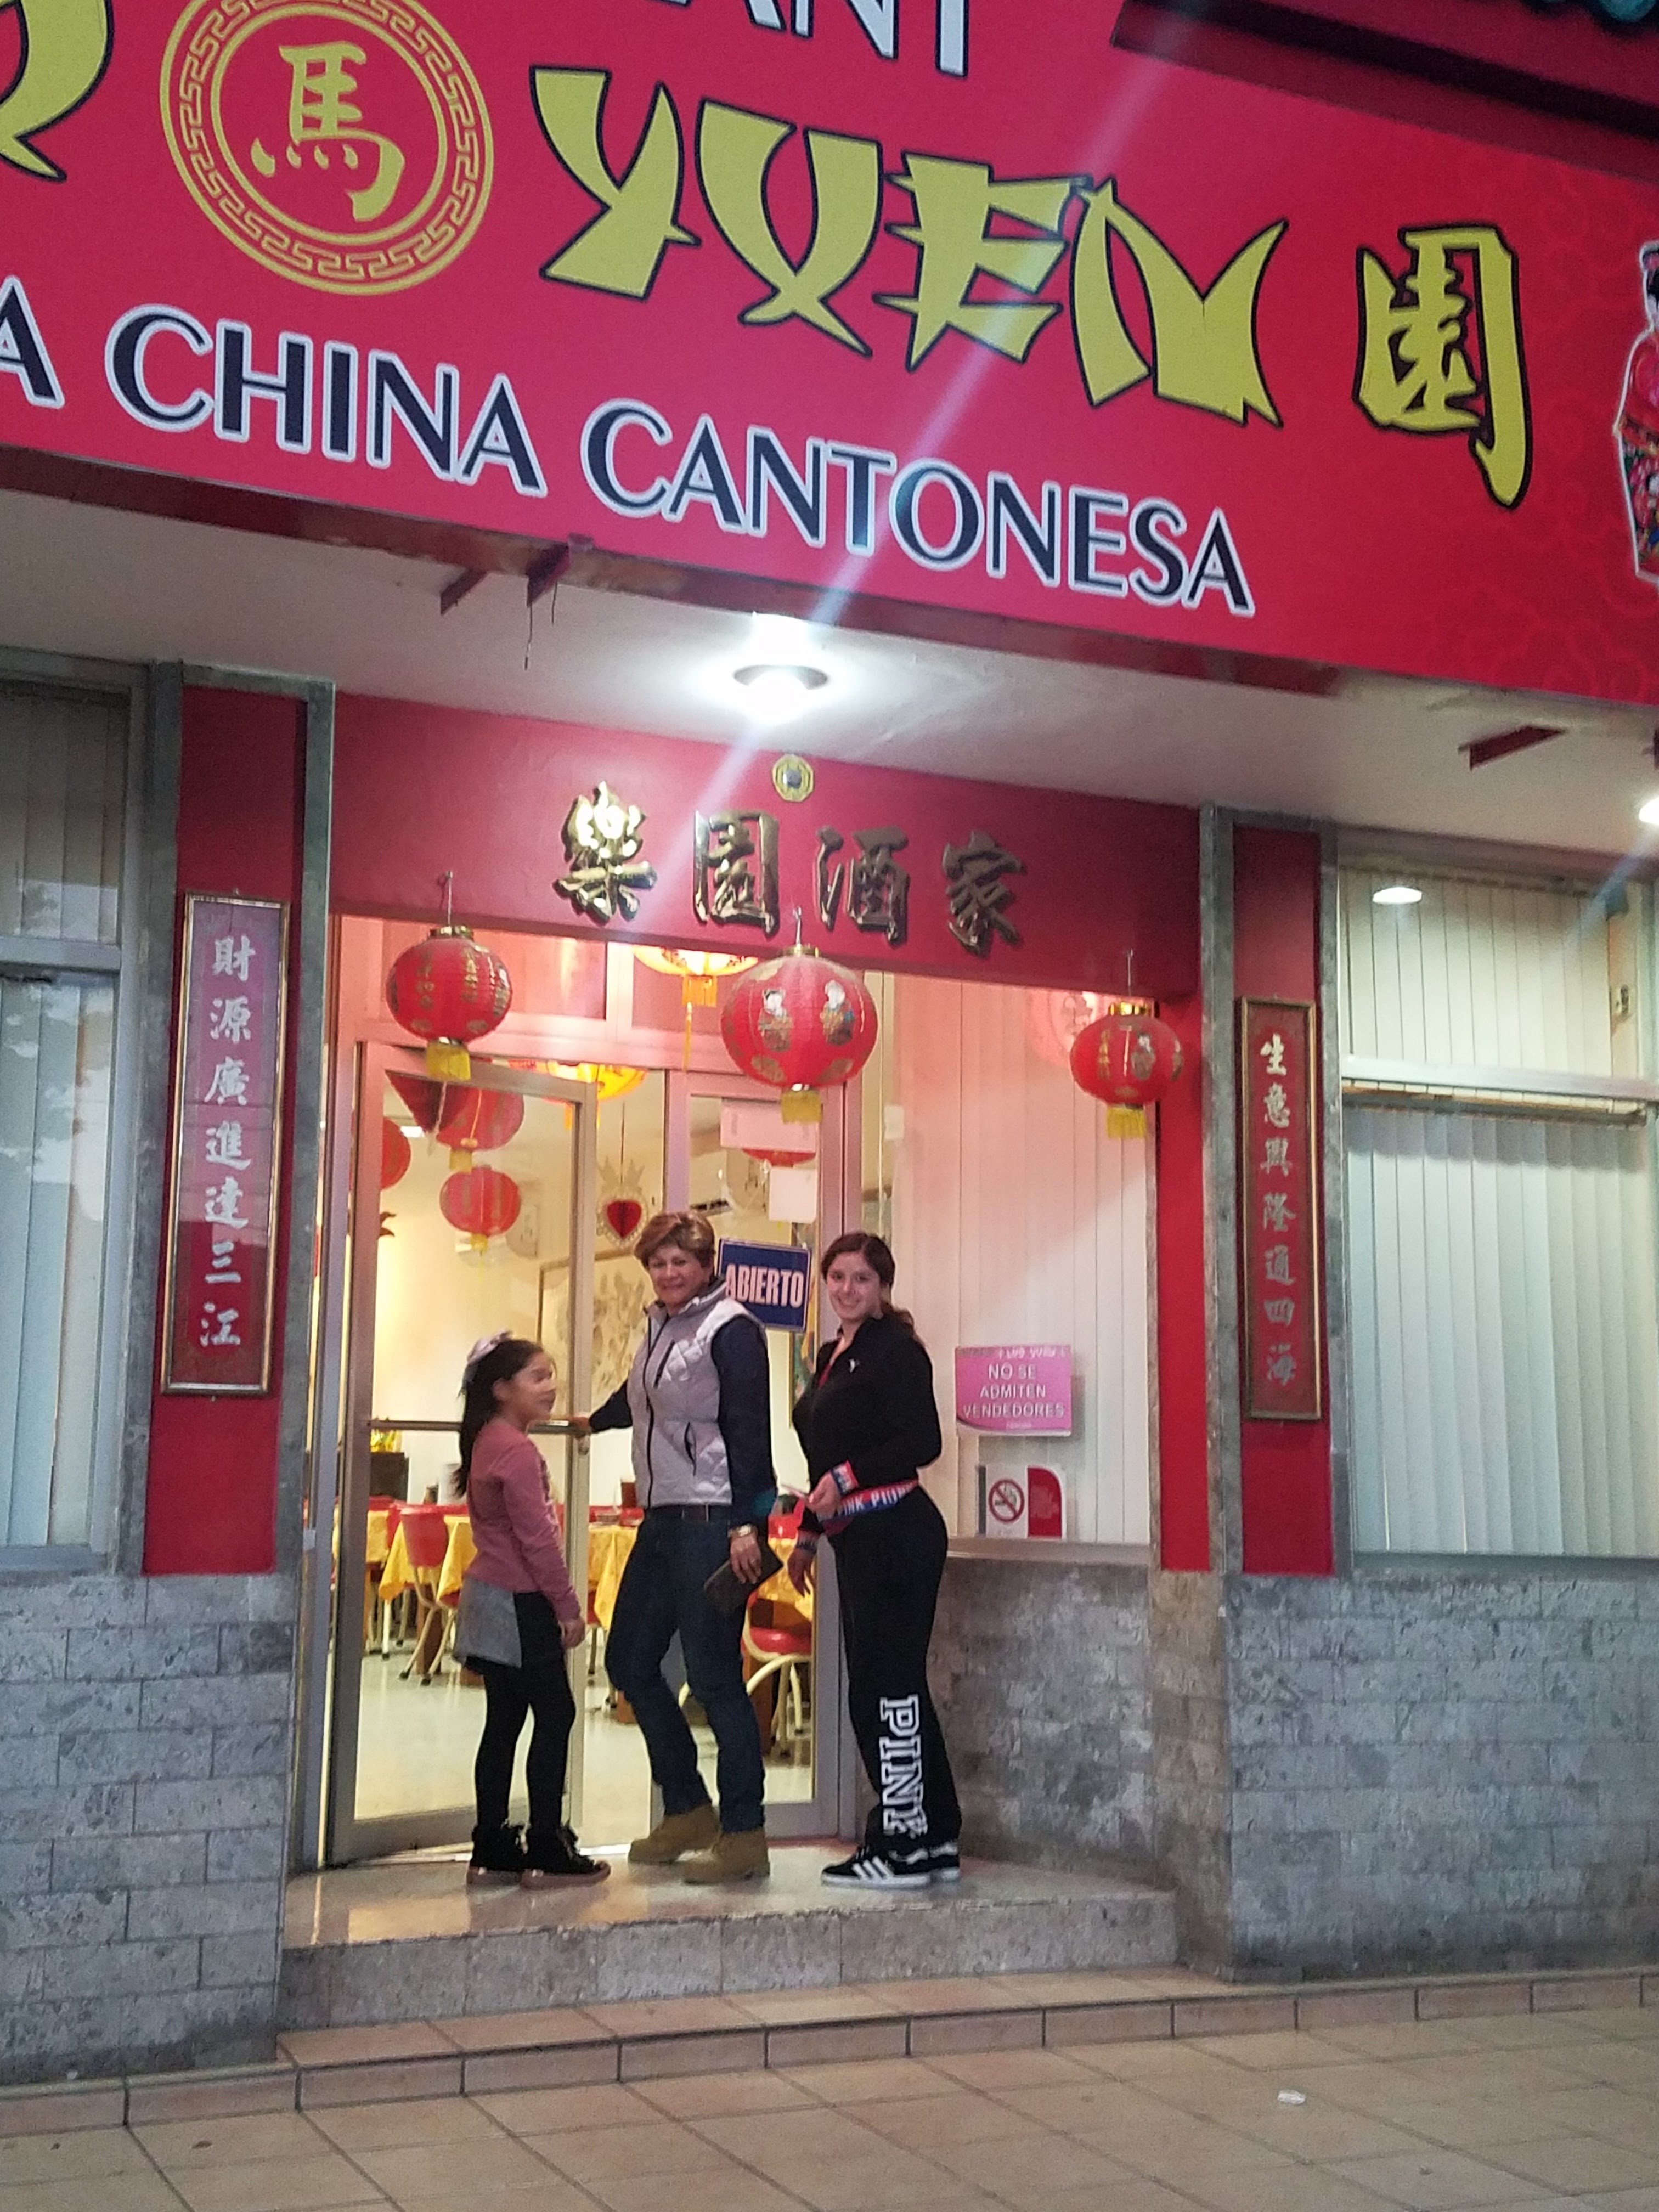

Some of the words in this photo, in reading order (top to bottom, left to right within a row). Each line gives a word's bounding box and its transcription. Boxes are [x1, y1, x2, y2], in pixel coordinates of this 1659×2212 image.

[250, 41, 406, 221] 馬
[104, 304, 549, 498] CHINA
[580, 398, 1255, 618] CANTONESA
[200, 935, 256, 1347] 財源廣進達三江
[725, 1263, 804, 1308] ABIERTO
[962, 1402, 1064, 1419] VENDEDORES
[980, 1383, 1046, 1400] ADMITEN
[988, 1362, 1013, 1380] NO
[1018, 1363, 1037, 1380] SE
[879, 1693, 928, 1839] PINK
